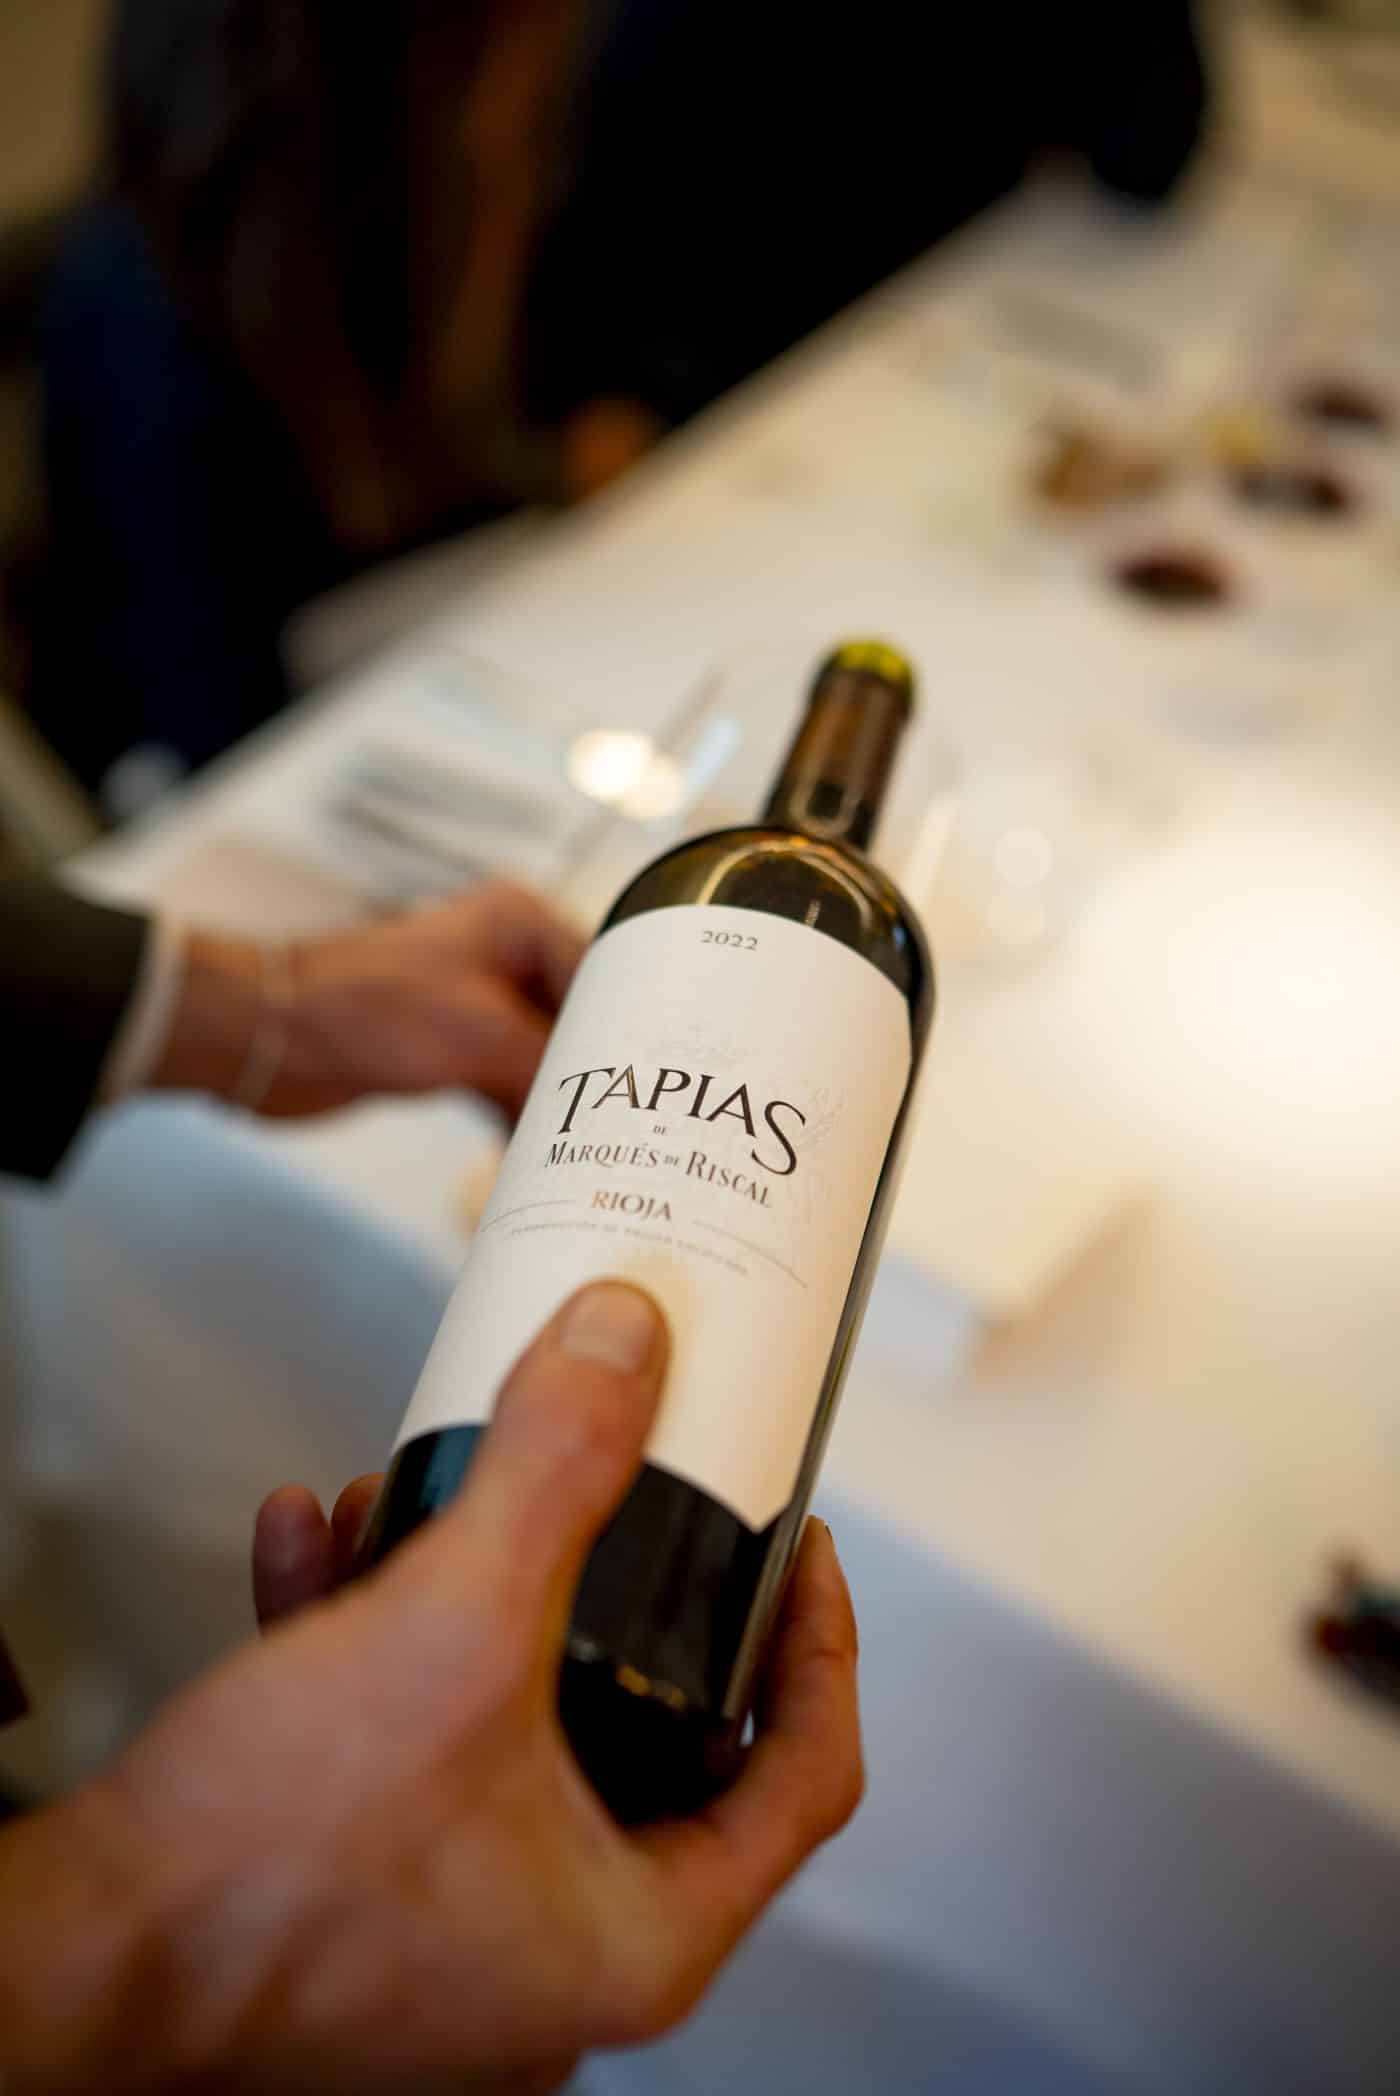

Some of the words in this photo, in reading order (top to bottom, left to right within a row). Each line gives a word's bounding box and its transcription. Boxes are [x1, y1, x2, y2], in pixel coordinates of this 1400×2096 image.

[701, 930, 758, 951] 2022
[558, 1064, 806, 1175] TAPIAS
[544, 1141, 660, 1168] MARQUÉS
[685, 1151, 774, 1208] RISCAL
[591, 1190, 672, 1221] RIOJA
